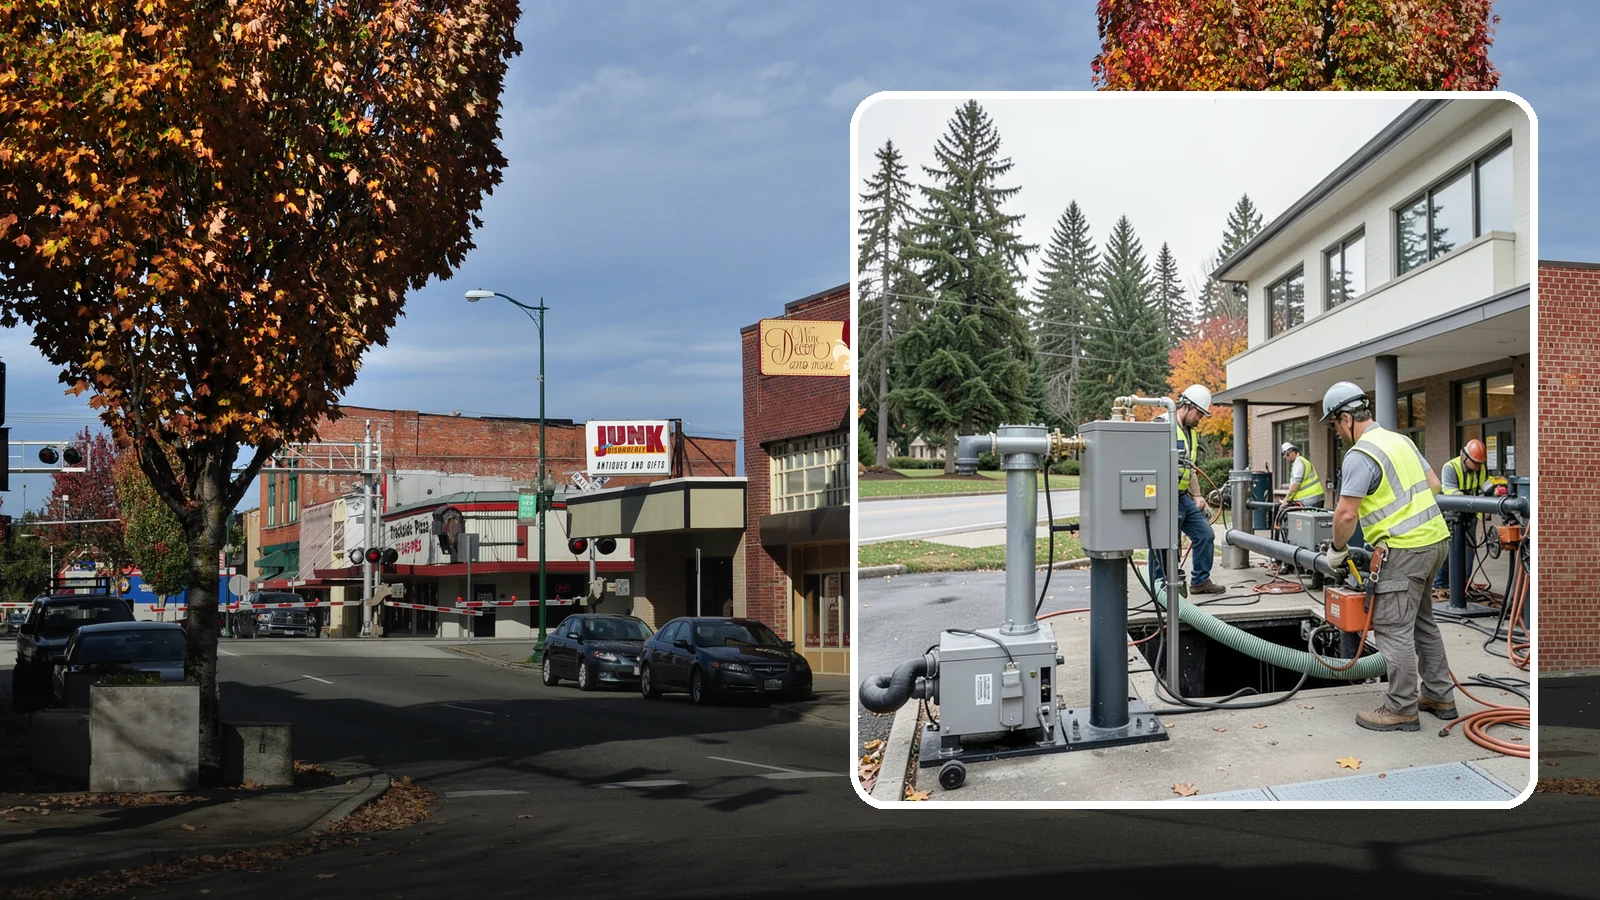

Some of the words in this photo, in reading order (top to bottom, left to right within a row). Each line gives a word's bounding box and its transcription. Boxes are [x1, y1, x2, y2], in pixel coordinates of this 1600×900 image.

[595, 425, 666, 457] JUNK
[608, 446, 646, 454] DISORDERLY
[596, 461, 628, 470] ANTIQUES
[631, 461, 644, 470] AND
[647, 460, 666, 470] GIFTS
[414, 519, 429, 535] Pizza
